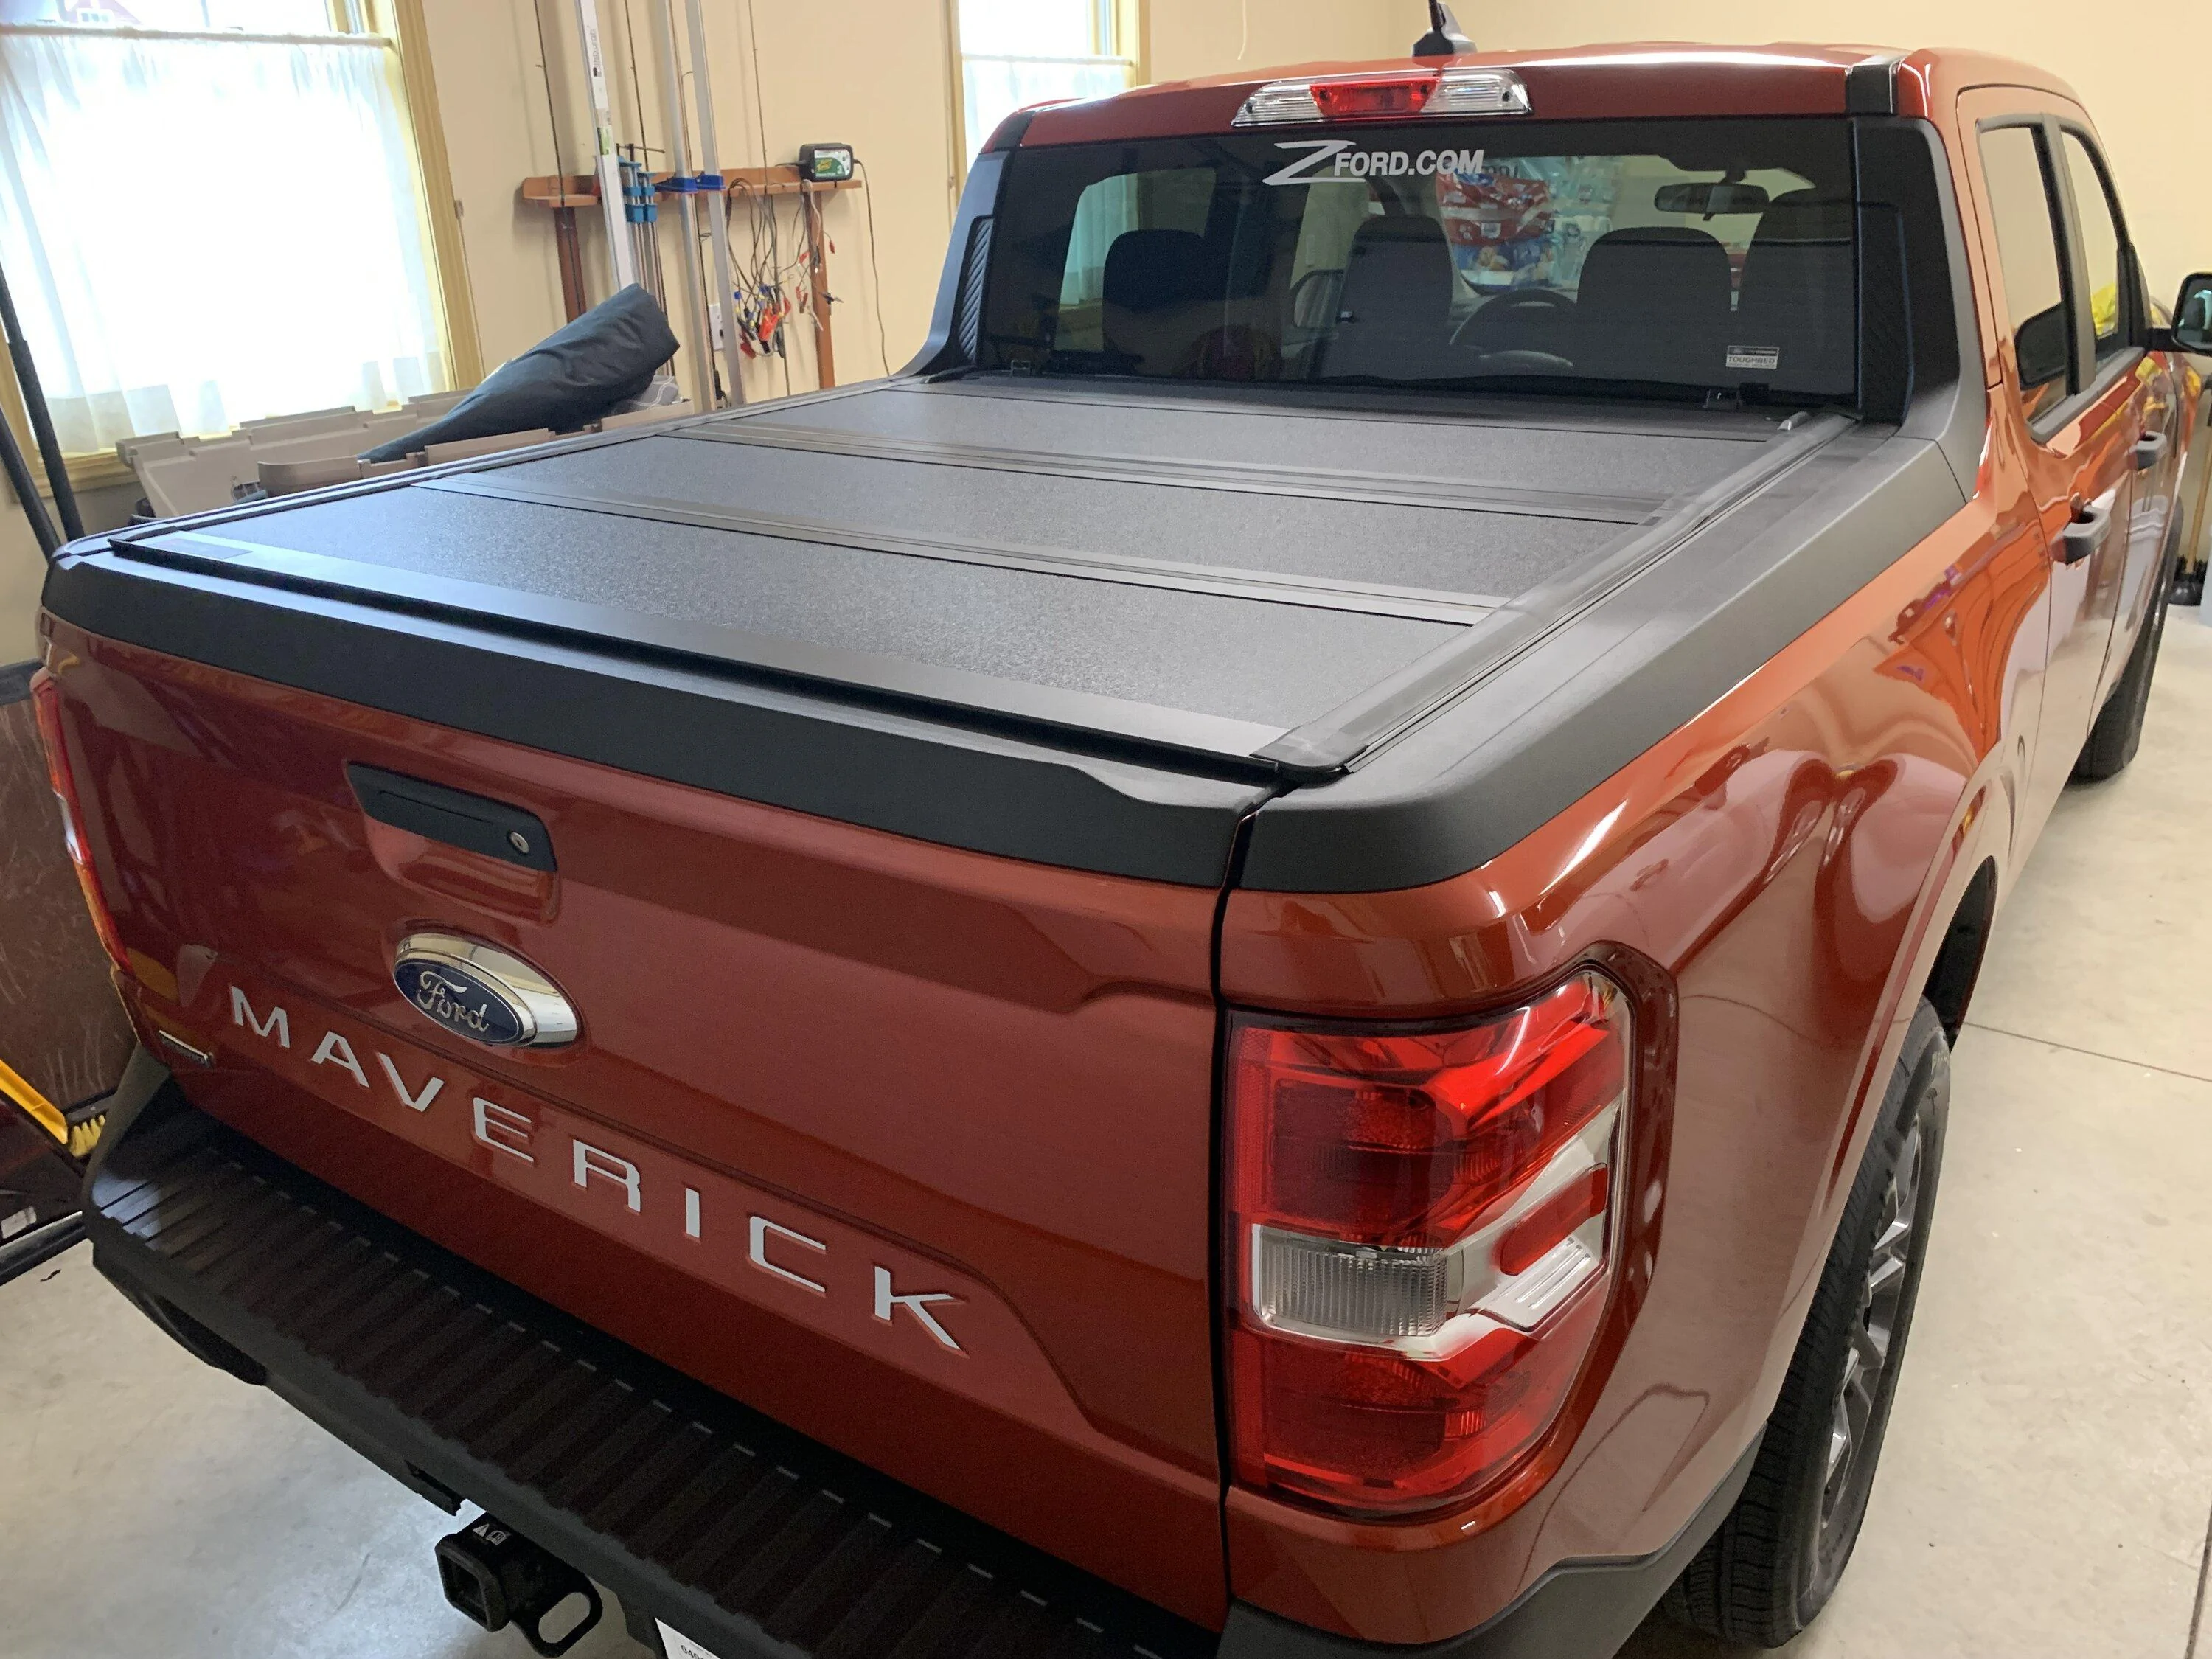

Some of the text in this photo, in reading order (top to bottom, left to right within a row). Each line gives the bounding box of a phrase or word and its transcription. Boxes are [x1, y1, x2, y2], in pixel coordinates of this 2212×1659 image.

[1262, 139, 1484, 186] ZFORD.COM
[416, 970, 490, 1032] Ford
[229, 985, 963, 1352] MAVERICK
